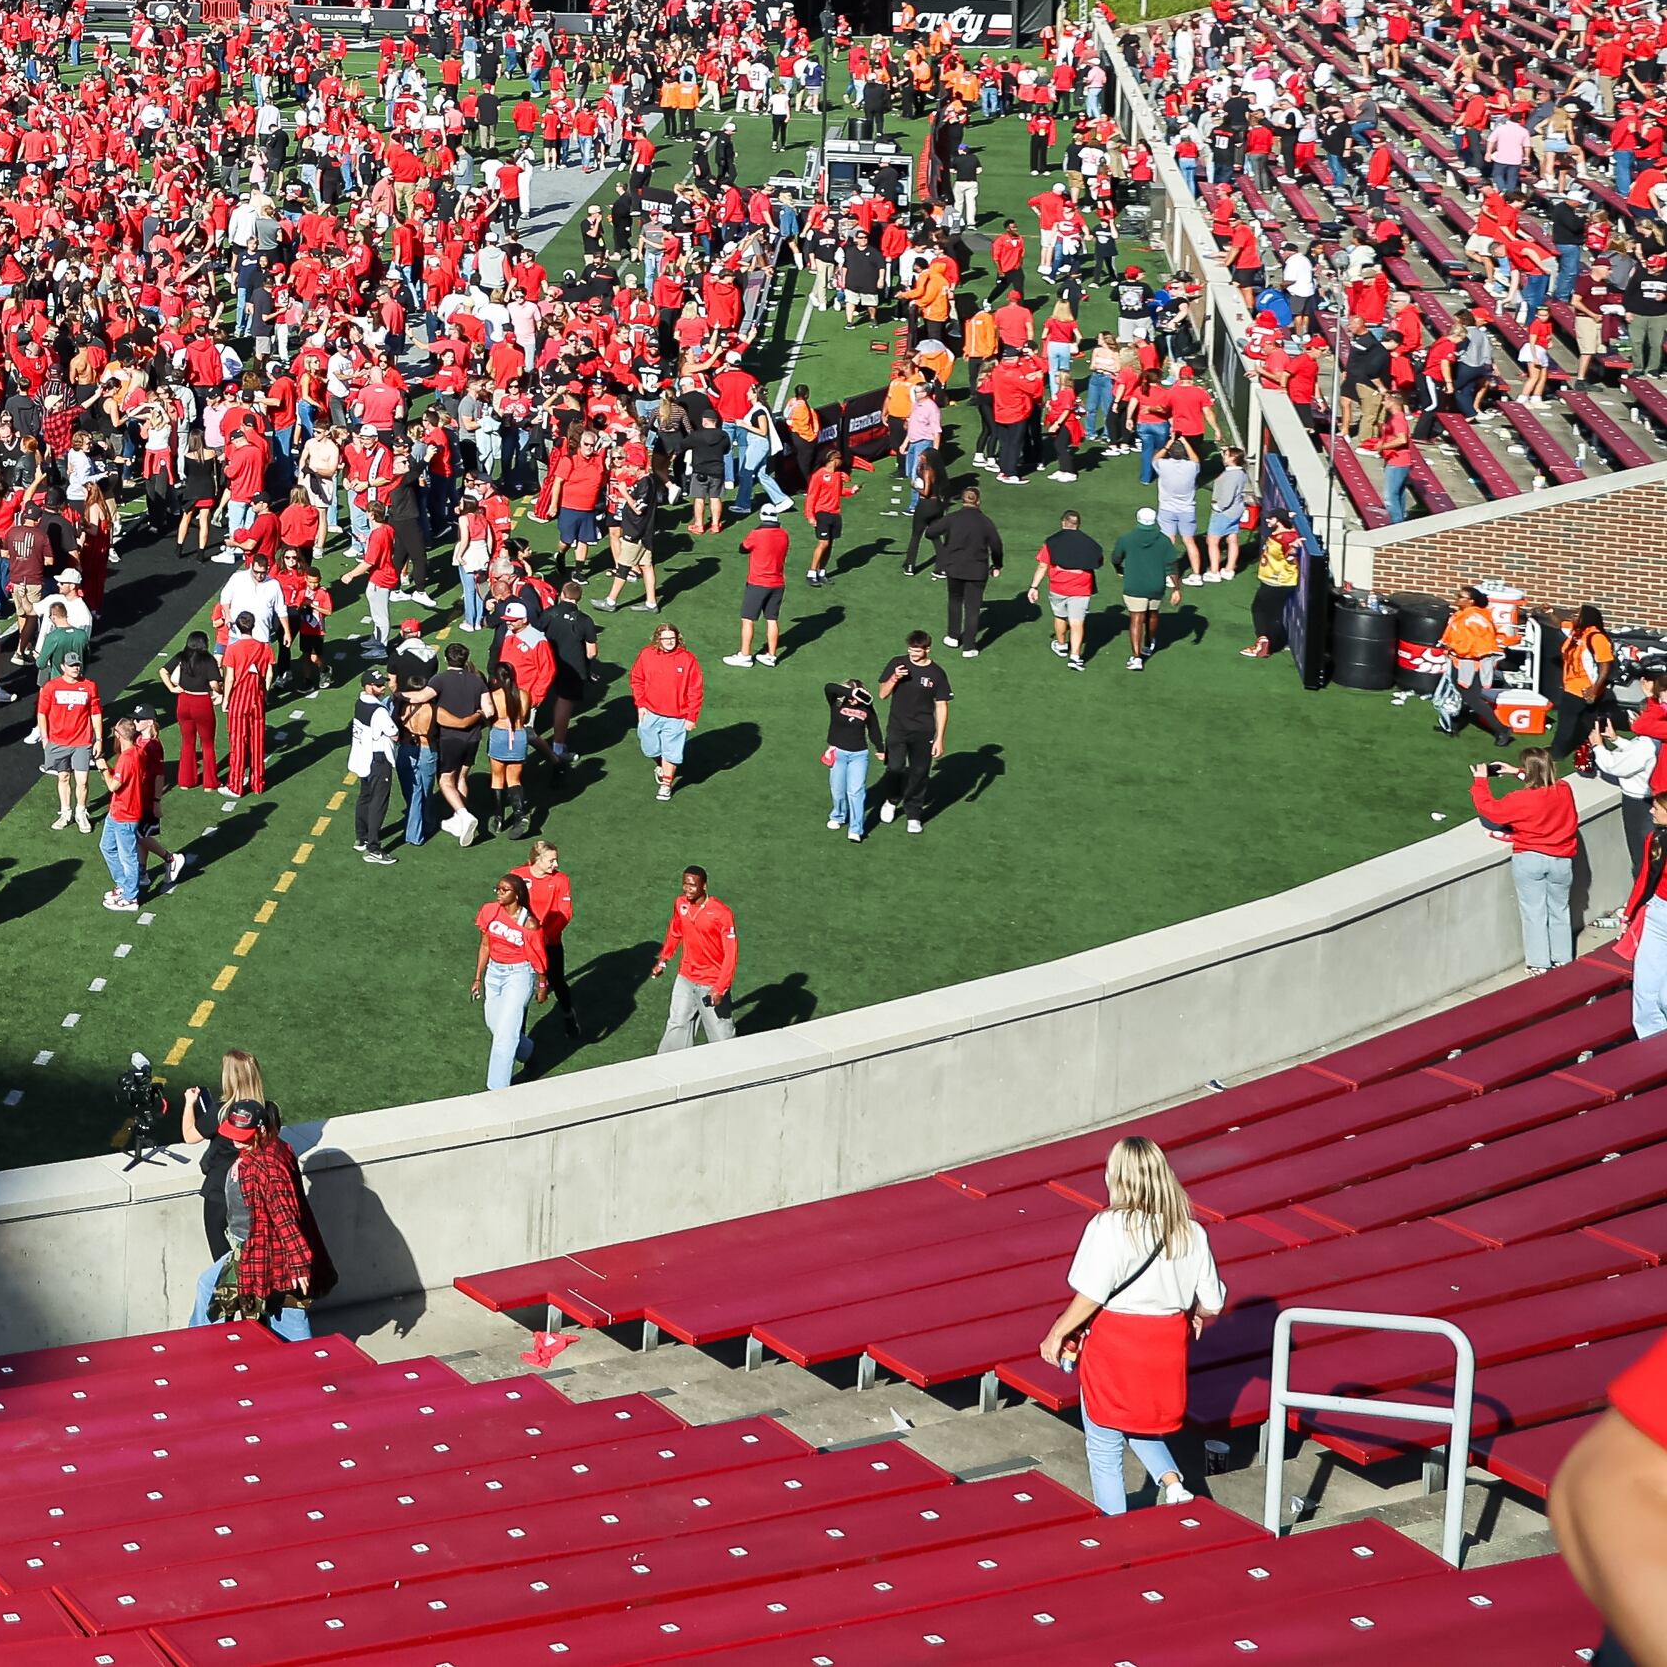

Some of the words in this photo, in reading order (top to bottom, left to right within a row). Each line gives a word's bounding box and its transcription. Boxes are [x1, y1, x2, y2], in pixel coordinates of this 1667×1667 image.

[330, 14, 350, 22] LEVEL
[641, 373, 659, 393] 18
[1509, 709, 1531, 729] G
